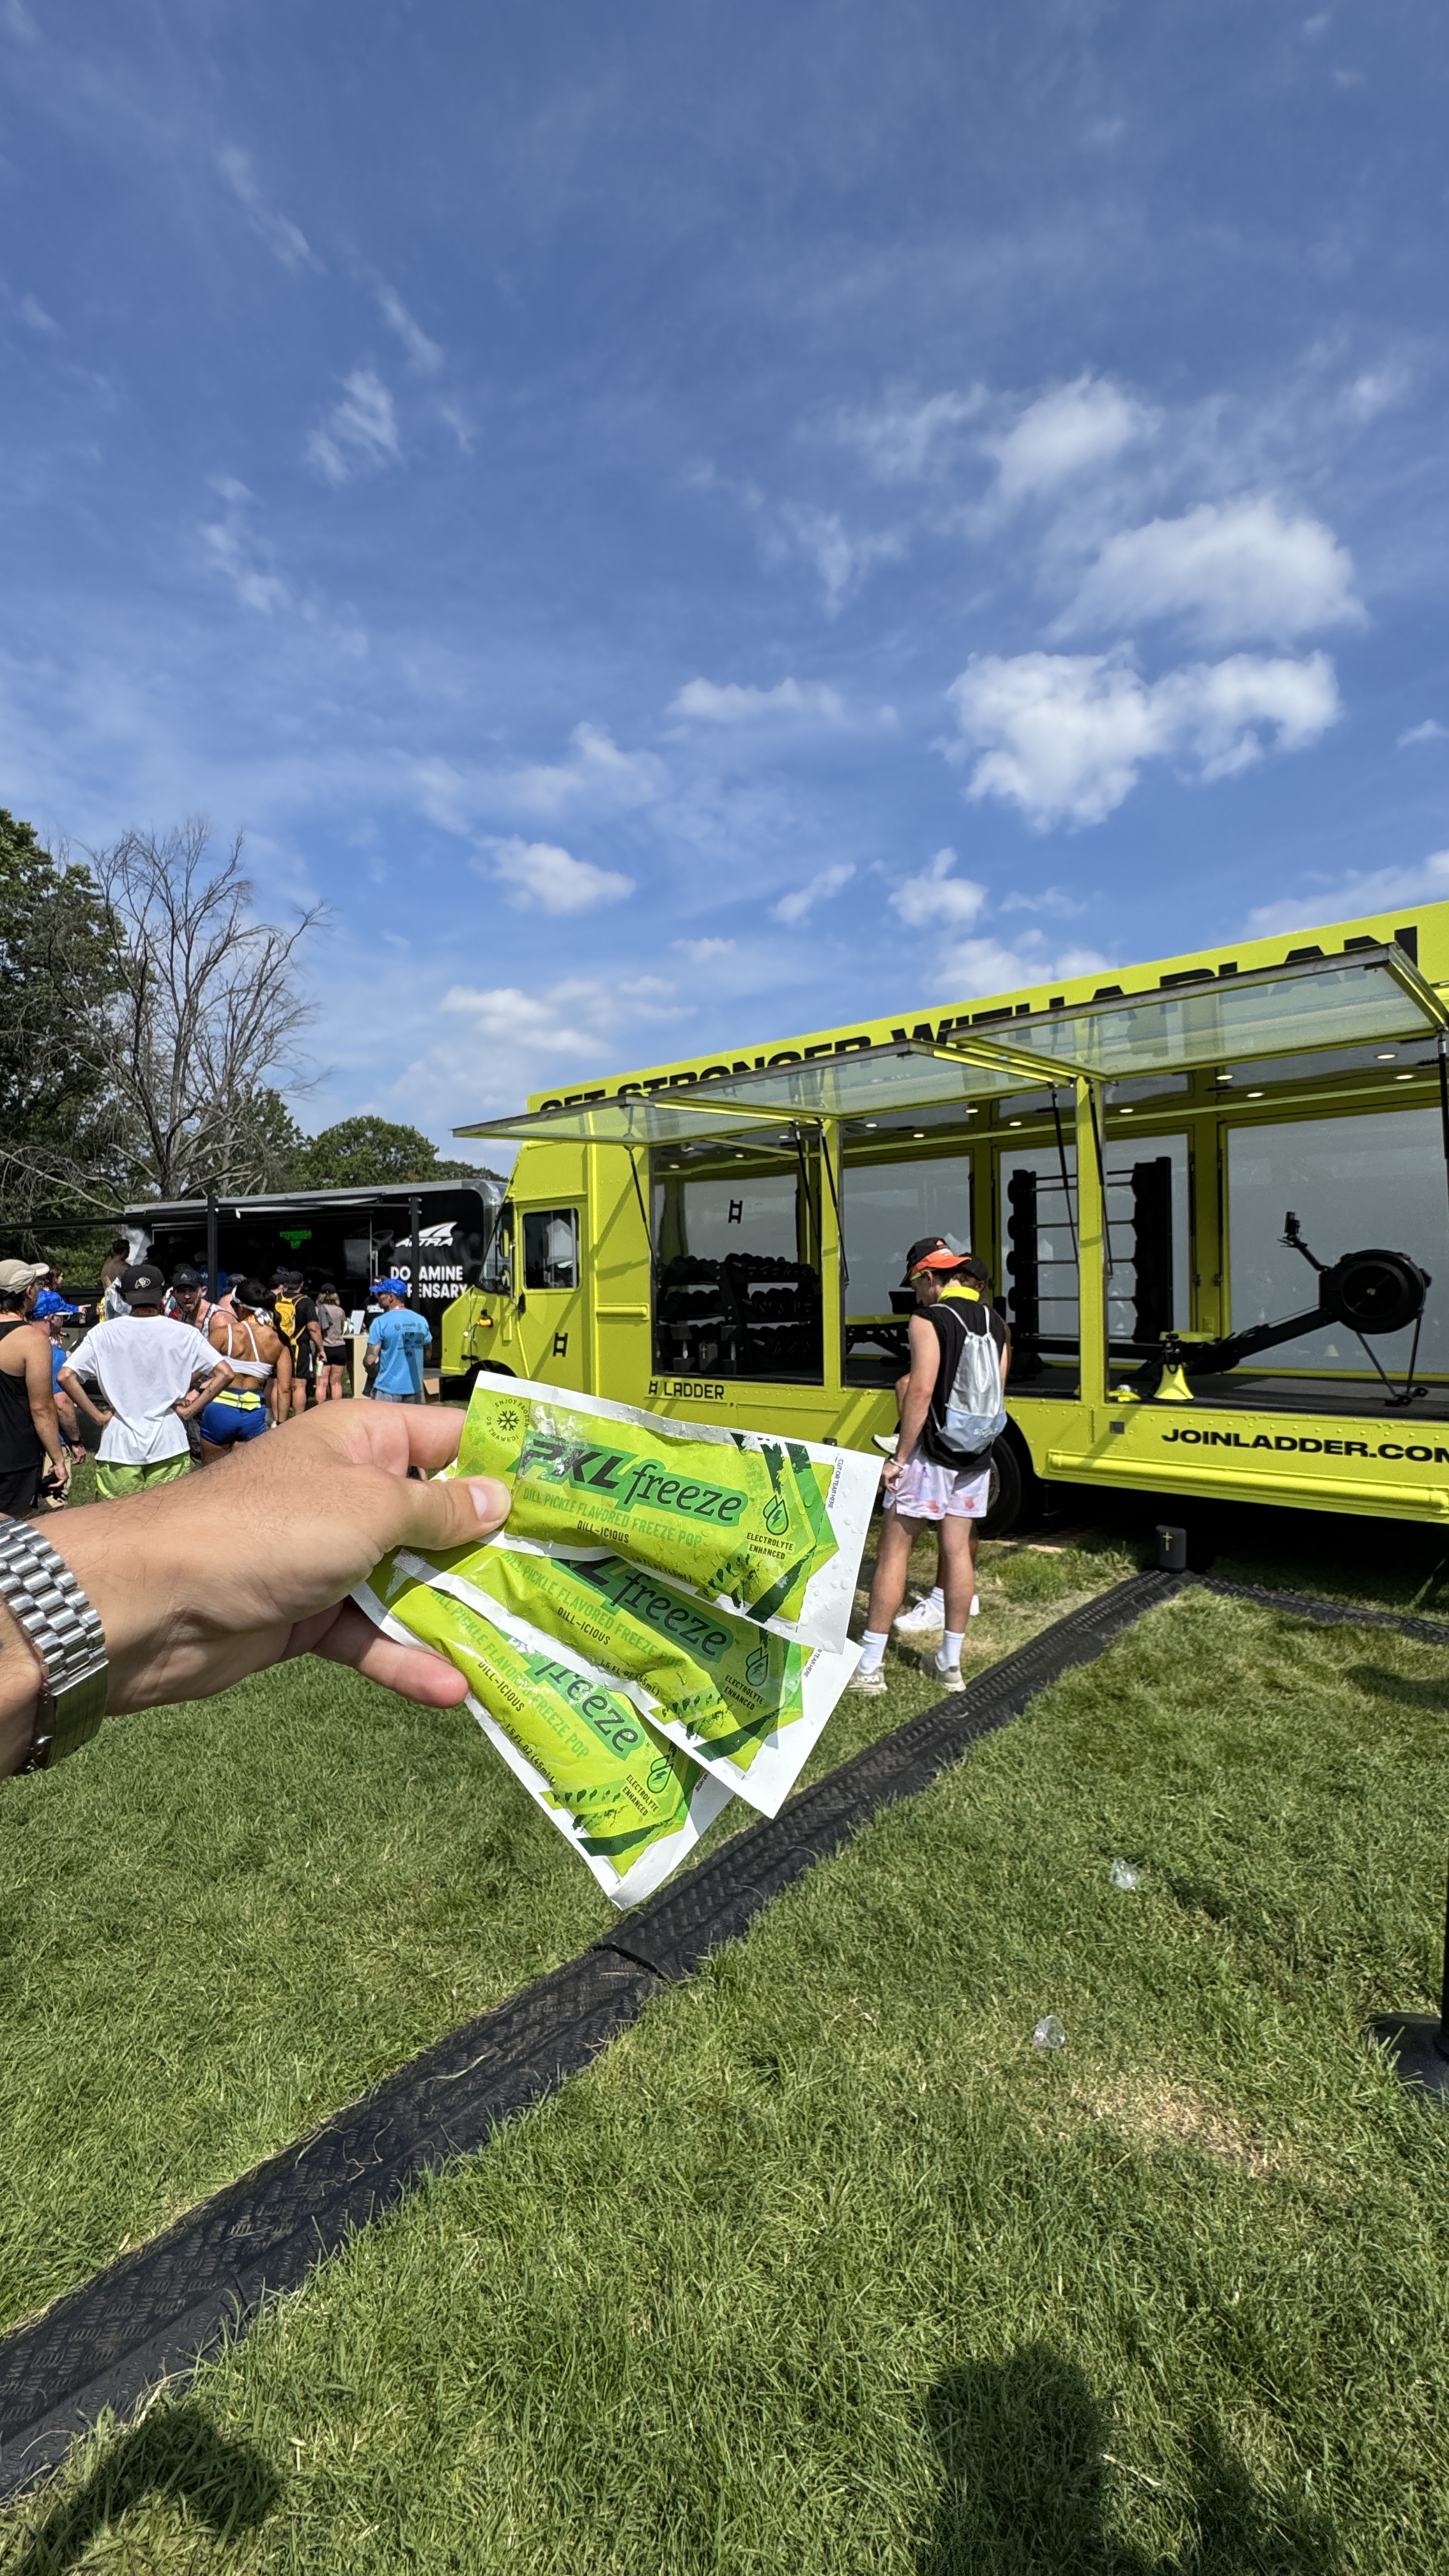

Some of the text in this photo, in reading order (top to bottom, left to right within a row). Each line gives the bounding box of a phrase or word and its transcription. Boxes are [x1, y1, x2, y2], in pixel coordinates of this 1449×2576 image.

[390, 1265, 464, 1282] DOAMINE
[494, 1398, 518, 1408] ENJOY
[664, 1381, 724, 1400] LADDER
[623, 1462, 742, 1522] freeze
[523, 1487, 703, 1549] DILL PICKLE FLAVORED FREEZE POP
[746, 1531, 794, 1551] ELECTROLYTE
[749, 1544, 786, 1560] ENHANCED
[522, 1564, 558, 1595] PICKLE
[556, 1586, 615, 1630] FLAVORED
[612, 1623, 659, 1657] FREEZE
[609, 1571, 727, 1657] freeze
[450, 1605, 488, 1646] PICKLE
[531, 1694, 571, 1738] FREEZE
[565, 1732, 590, 1758] POP
[724, 1674, 765, 1705] ELECTROLYTE
[724, 1685, 755, 1710] ENHANCED
[622, 1786, 648, 1817] ENHANCED
[625, 1774, 659, 1813] ELECTROLYTE
